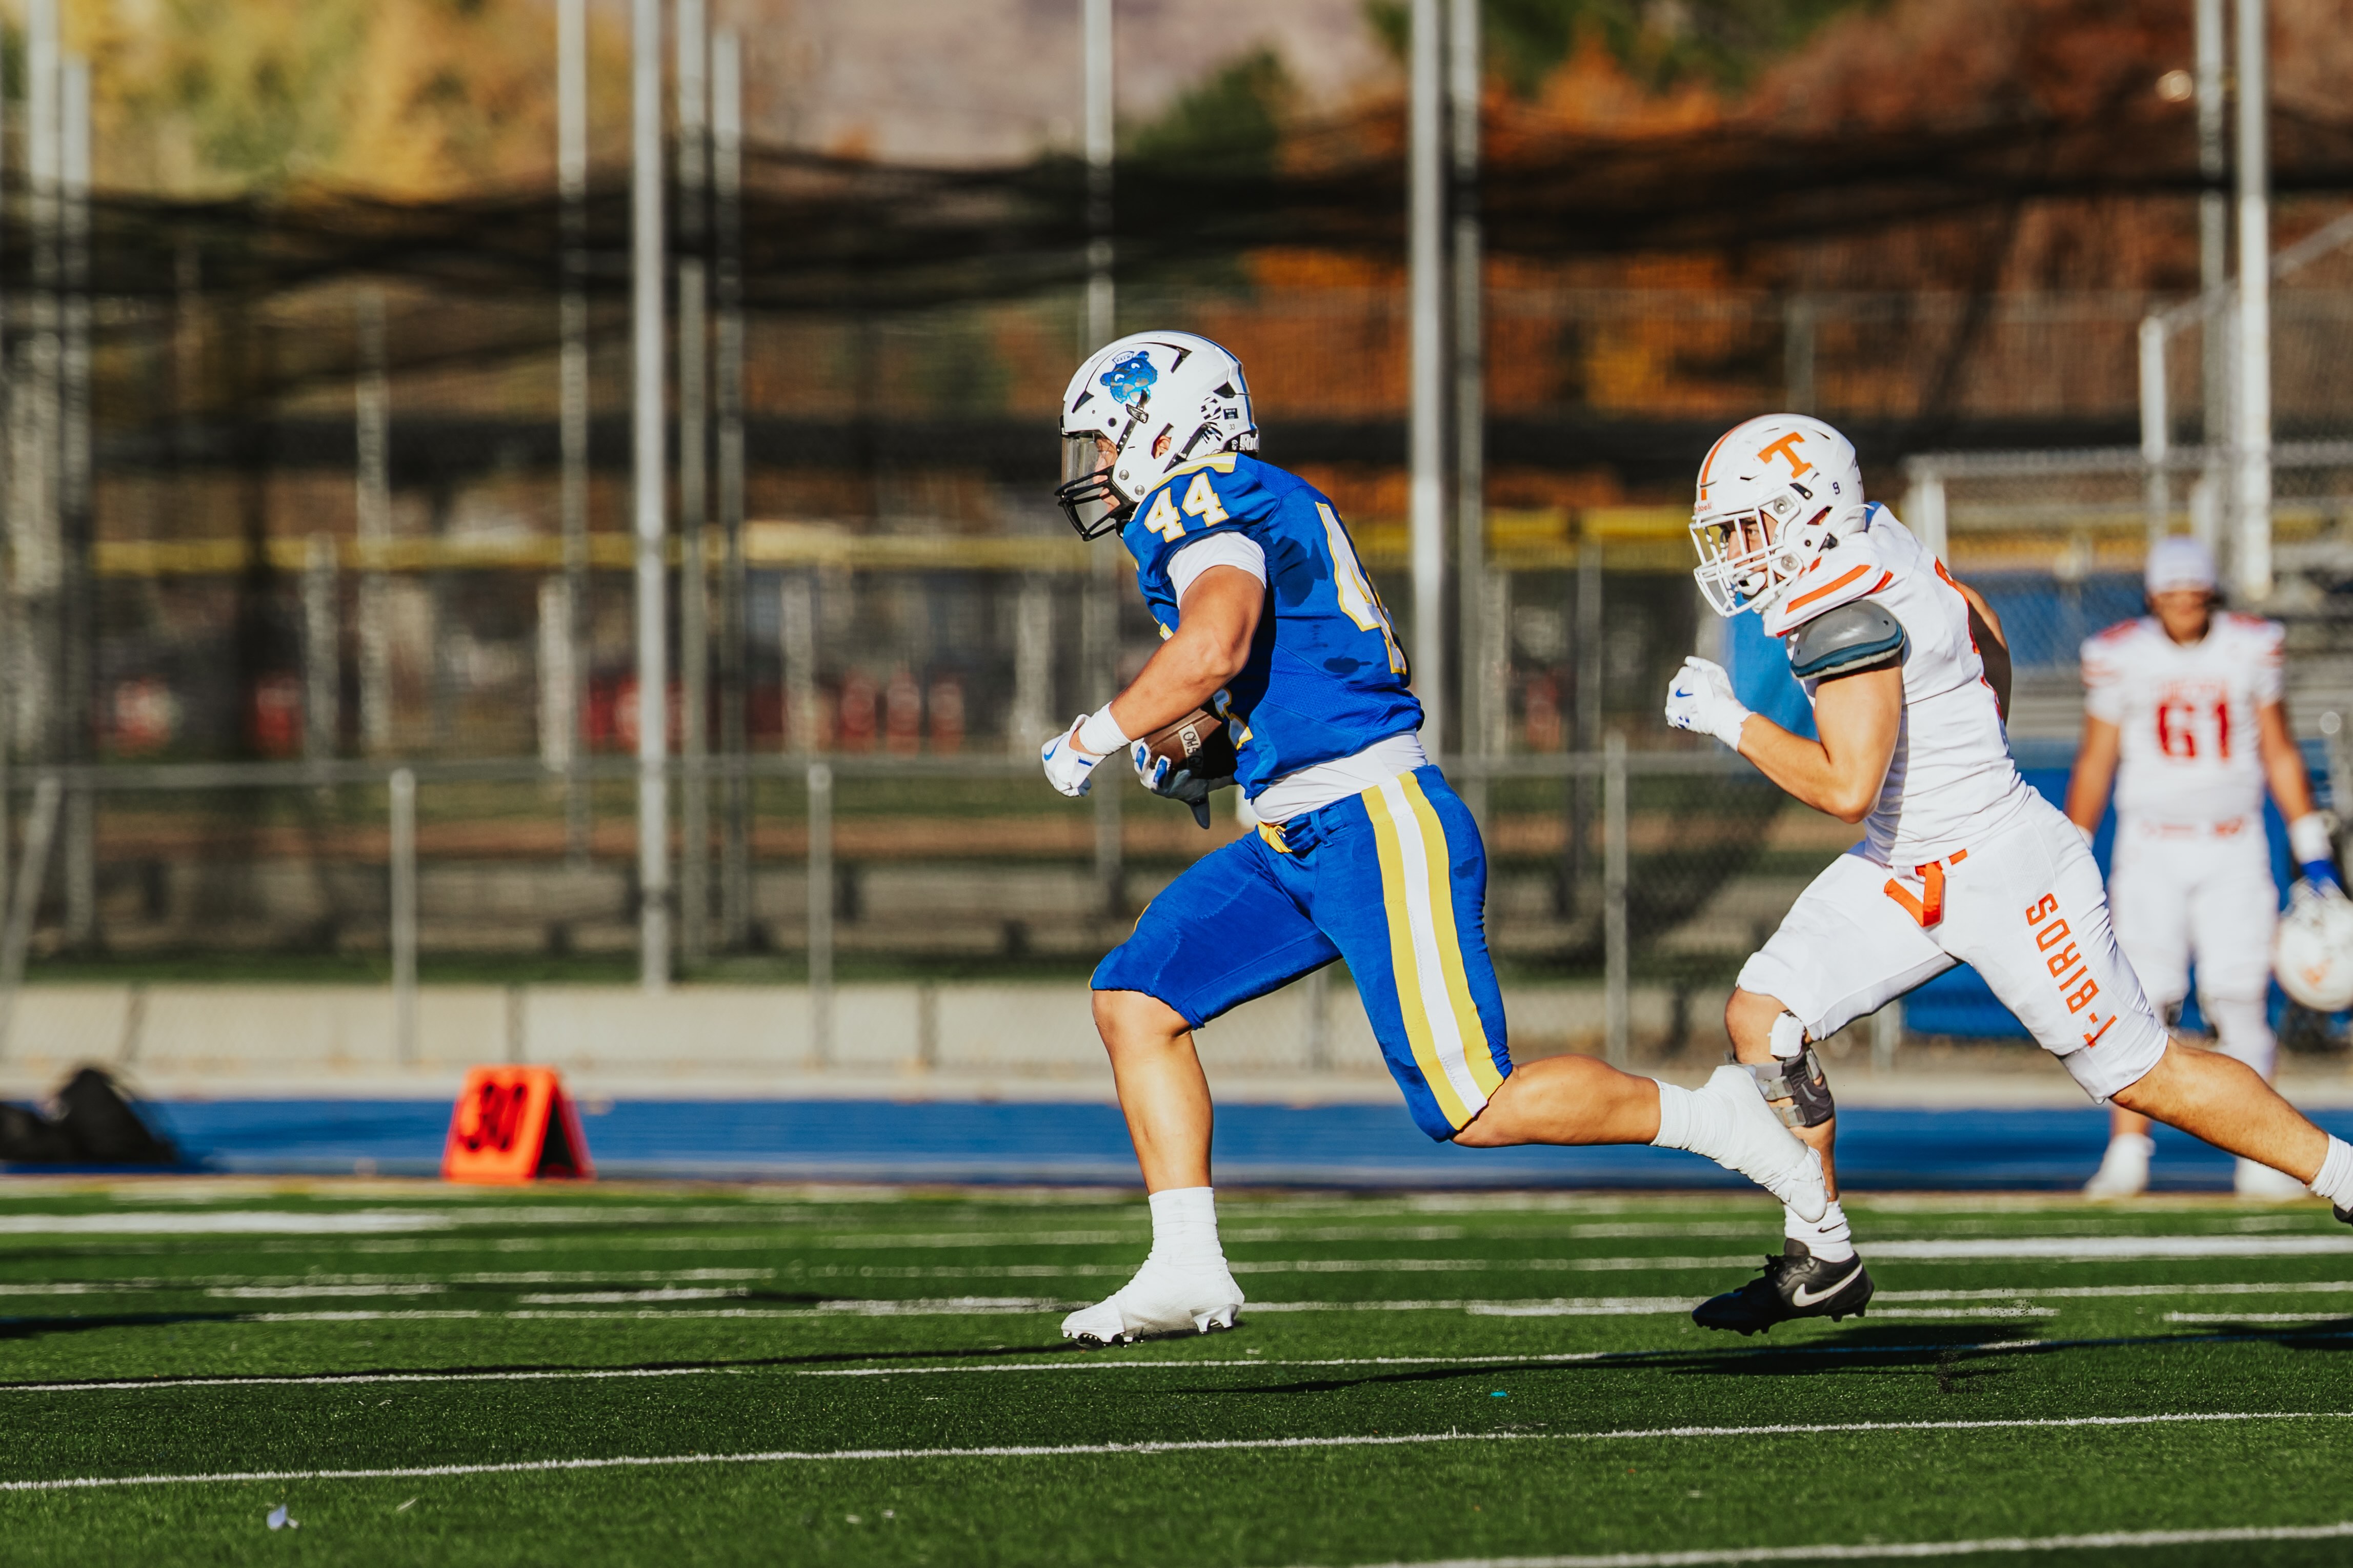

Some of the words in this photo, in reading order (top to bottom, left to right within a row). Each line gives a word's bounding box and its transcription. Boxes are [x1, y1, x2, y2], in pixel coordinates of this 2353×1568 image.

[1758, 432, 1813, 479] T
[1144, 472, 1230, 543] 44
[1833, 482, 1840, 495] 9
[2156, 700, 2231, 762] 61
[2026, 893, 2117, 1048] T-BIRDS
